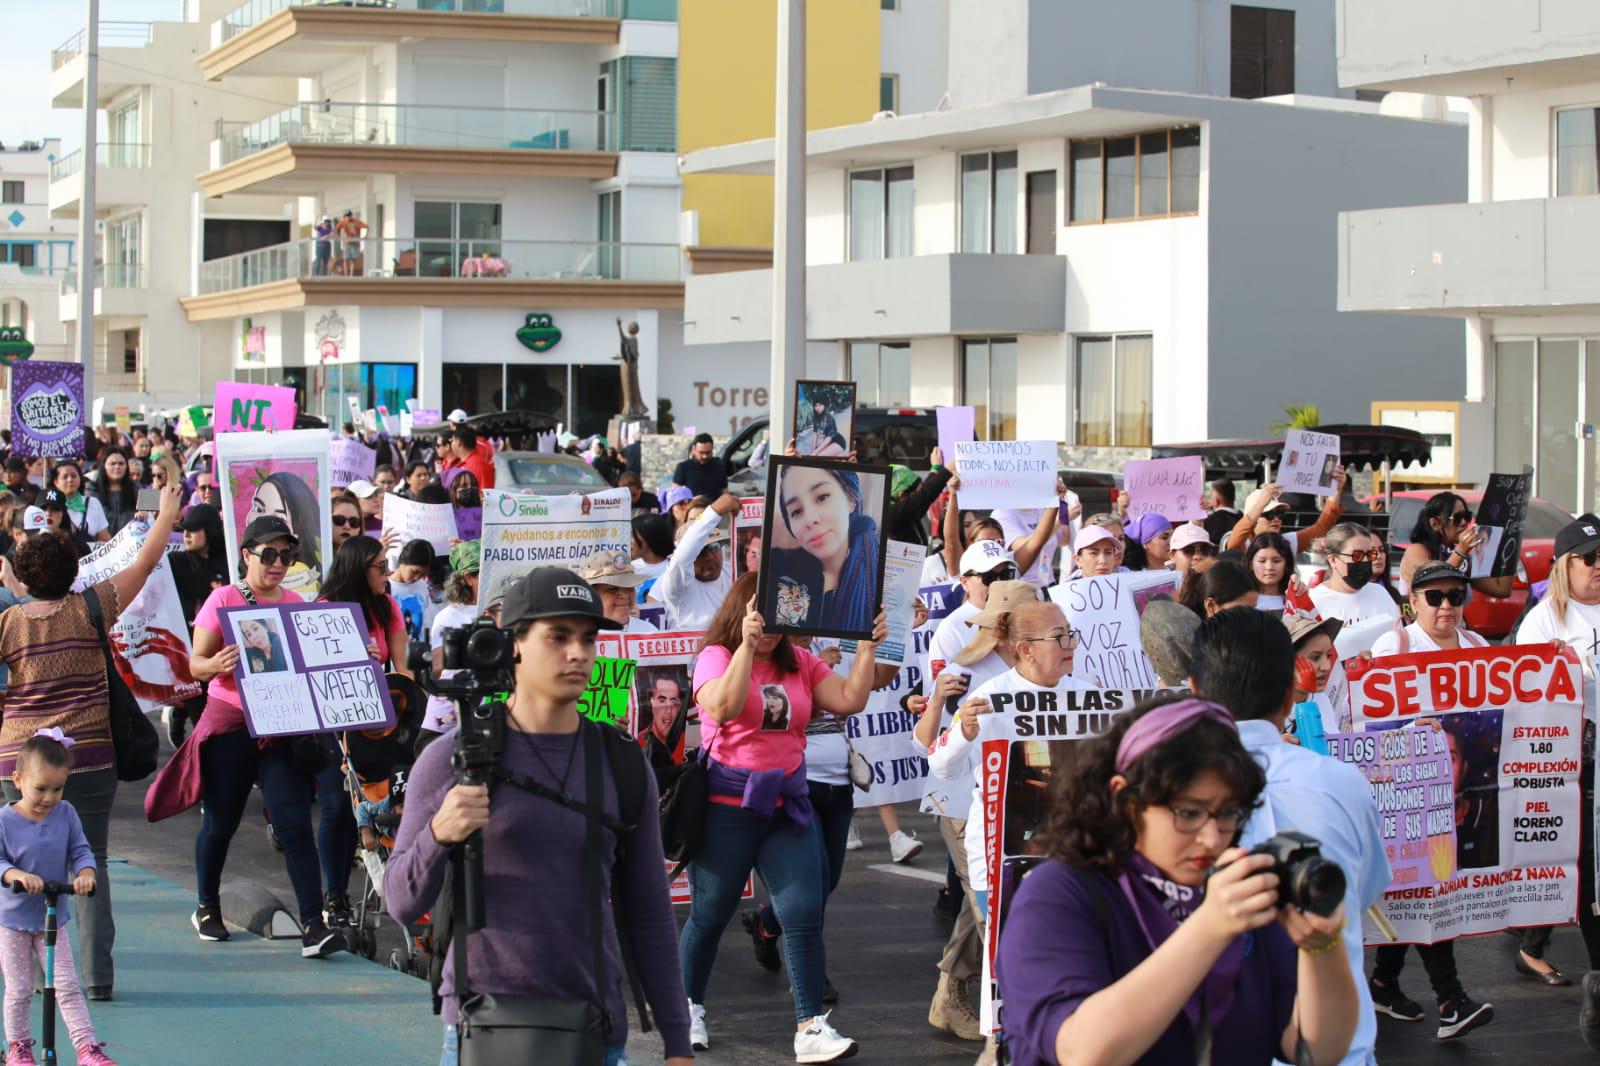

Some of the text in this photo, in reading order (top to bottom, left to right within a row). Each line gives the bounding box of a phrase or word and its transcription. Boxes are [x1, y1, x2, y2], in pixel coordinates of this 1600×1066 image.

[21, 394, 64, 411] SOMOS EL
[693, 382, 768, 407] Torre
[231, 398, 272, 431] NI
[27, 437, 40, 448] NO
[57, 426, 84, 446] VAMOS
[31, 444, 76, 457] A CALLAR
[957, 441, 1031, 456] NO ESTAMOS
[993, 460, 1016, 472] NOS
[519, 504, 549, 516] Sinaloa
[484, 547, 525, 562] PABLO
[528, 545, 566, 560] ISMAEL
[1070, 577, 1120, 612] SOY
[294, 613, 357, 637] ES POR
[1076, 621, 1127, 651] VOZ
[315, 636, 345, 657] TI
[1362, 657, 1576, 719] SE BUSCA
[991, 690, 1057, 713] POR
[1067, 690, 1123, 711] LAS
[323, 701, 382, 725] QUE HOY
[1015, 714, 1067, 737] SIN
[1513, 725, 1569, 739] ESTATURA
[1344, 736, 1376, 763] LOS
[1384, 733, 1407, 761] OJOS
[1414, 730, 1427, 757] DE
[1529, 742, 1553, 754] 1.80
[1395, 758, 1450, 784] LOS SIGAN A
[1502, 757, 1578, 774] COMPLEXIÓN
[1513, 777, 1565, 789] ROBUSTA
[1396, 785, 1425, 812] DONDE
[1429, 783, 1453, 808] VAYAN
[1525, 801, 1551, 813] PIEL
[1384, 807, 1453, 841] DE SUS MADRES
[1514, 830, 1558, 843] CLARO
[1473, 868, 1523, 889] SANCHEZ
[1526, 866, 1566, 880] NAVA
[1413, 900, 1426, 910] de
[1524, 882, 1537, 892] las
[1545, 881, 1560, 892] pm
[1389, 913, 1403, 921] no
[1404, 911, 1417, 921] ha
